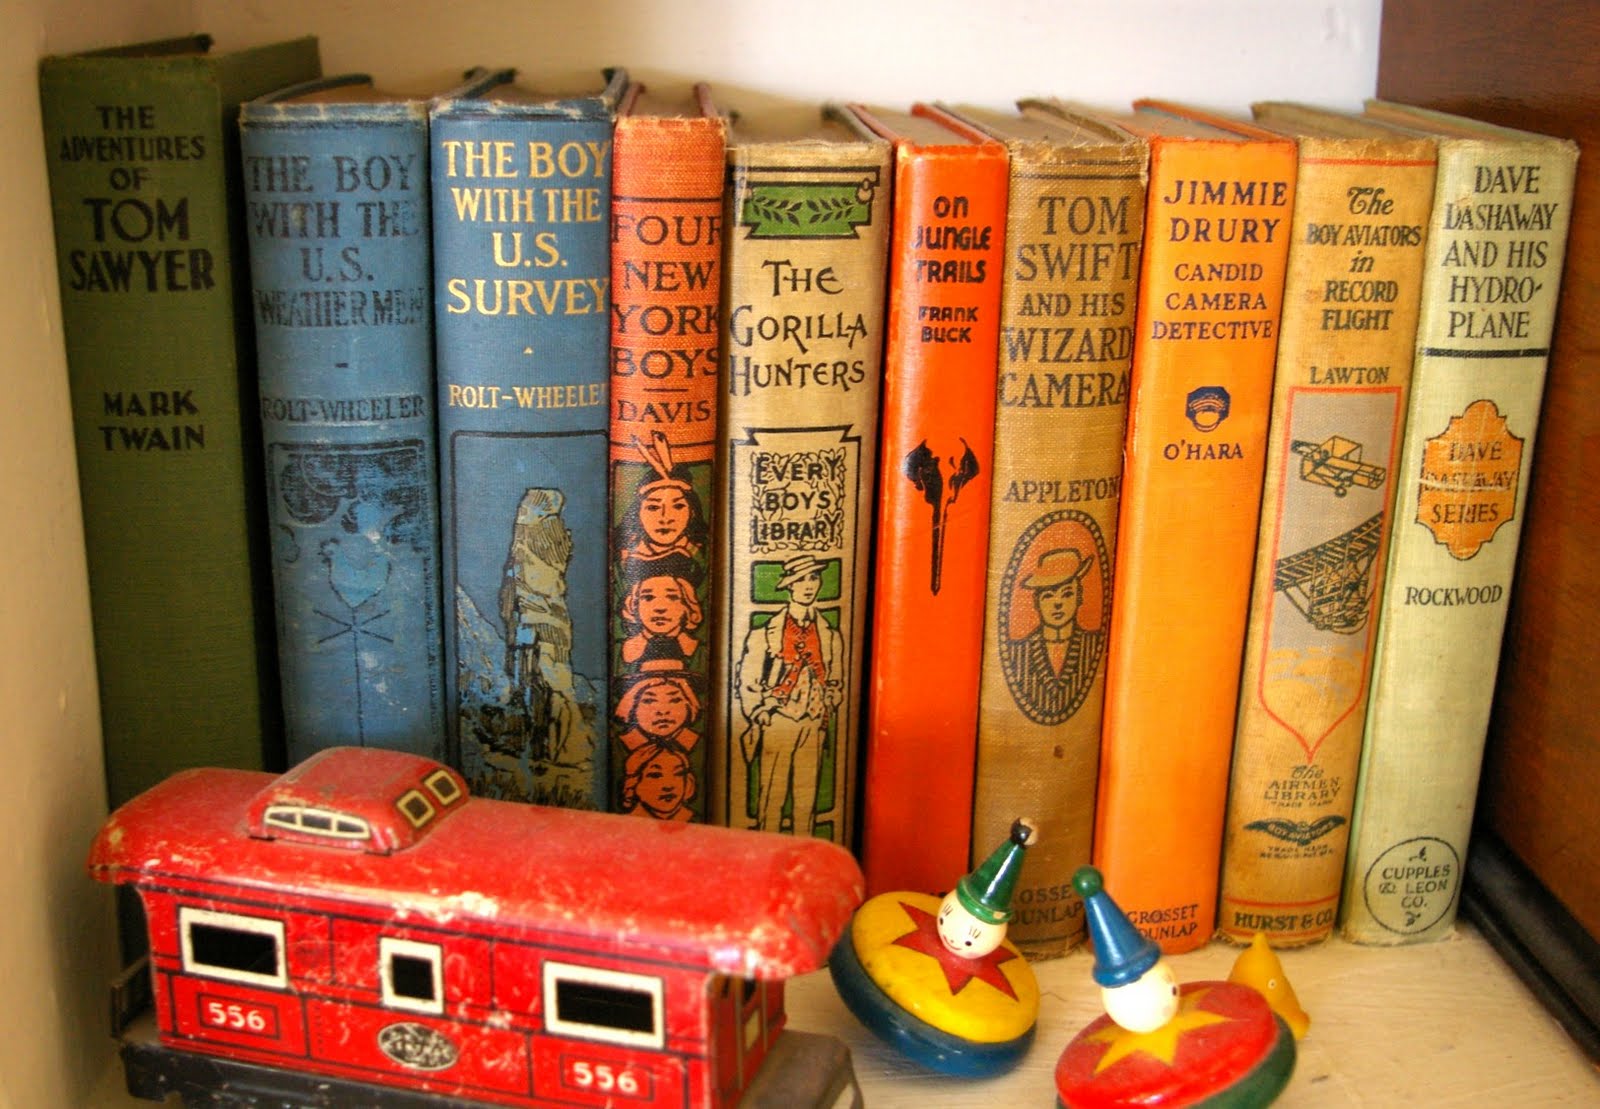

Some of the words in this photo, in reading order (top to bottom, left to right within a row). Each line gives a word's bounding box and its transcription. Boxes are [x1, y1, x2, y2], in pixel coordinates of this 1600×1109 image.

[96, 106, 155, 130] THE
[60, 136, 205, 162] ADVENTURES
[442, 140, 518, 179] THE
[528, 139, 611, 178] BOY
[109, 167, 152, 191] OF
[248, 155, 314, 192] THE
[333, 154, 416, 192] BOY
[1474, 165, 1541, 194] DAVE
[451, 187, 533, 222] WITH
[542, 187, 601, 223] THE
[1163, 180, 1288, 207] JIMMIE
[1347, 186, 1395, 216] The
[83, 197, 190, 242] TOM
[250, 201, 341, 239] WITH
[356, 201, 419, 238] THE
[1037, 196, 1131, 236] TOM
[1442, 203, 1558, 231] DASHAWAY
[1170, 217, 1281, 243] DRURY
[1306, 224, 1341, 245] BOY
[1343, 225, 1422, 247] AVIATORS
[492, 232, 568, 268] U.S.
[1015, 242, 1140, 282] SWIFT
[1348, 250, 1375, 273] in
[1441, 240, 1497, 267] AND
[1507, 240, 1548, 268] HIS
[69, 248, 216, 292] SAWYER
[300, 247, 374, 282] U.S.
[623, 260, 716, 292] NEW
[761, 259, 845, 297] THE
[915, 259, 987, 284] TRAILS
[1174, 263, 1263, 282] CANDID
[447, 278, 609, 315] SURVEY
[1165, 292, 1267, 311] CAMERA
[1324, 280, 1398, 303] RECORD
[1450, 276, 1543, 303] HYDRO-
[1017, 294, 1071, 317] AND
[1078, 293, 1126, 317] HIS
[729, 304, 868, 354] GORILLA
[1151, 320, 1273, 340] DETECTIVE
[1321, 309, 1394, 331] FLIGHT
[1448, 311, 1530, 339] PLANE
[920, 326, 972, 344] BUCK
[1004, 325, 1134, 363] WIZARD
[612, 347, 718, 379] BOYS
[729, 355, 866, 396] HUNTERS
[1309, 366, 1390, 385] LAWTON
[103, 390, 198, 417] MARK
[1000, 372, 1130, 409] CAMERA
[617, 399, 711, 424] DAVIS
[98, 424, 205, 451] TWAIN
[1163, 439, 1244, 460] O'HARA
[1449, 441, 1503, 461] DAVE
[753, 455, 840, 485] EVERY
[764, 491, 831, 512] BOYS
[1002, 476, 1121, 504] APPLETON
[1430, 503, 1499, 524] SERIES
[752, 512, 840, 546] LIBRARY
[1405, 586, 1502, 606] ROCKWOOD
[1264, 787, 1341, 801] LIBRARY
[1268, 776, 1341, 790] AIRMEN
[1382, 864, 1450, 880] CUPPLES
[1405, 879, 1448, 893] LEON
[1401, 896, 1427, 909] CO.
[1235, 912, 1297, 931] HURST
[1301, 912, 1315, 926] &
[208, 1002, 266, 1031] 556
[573, 1061, 639, 1093] 556
